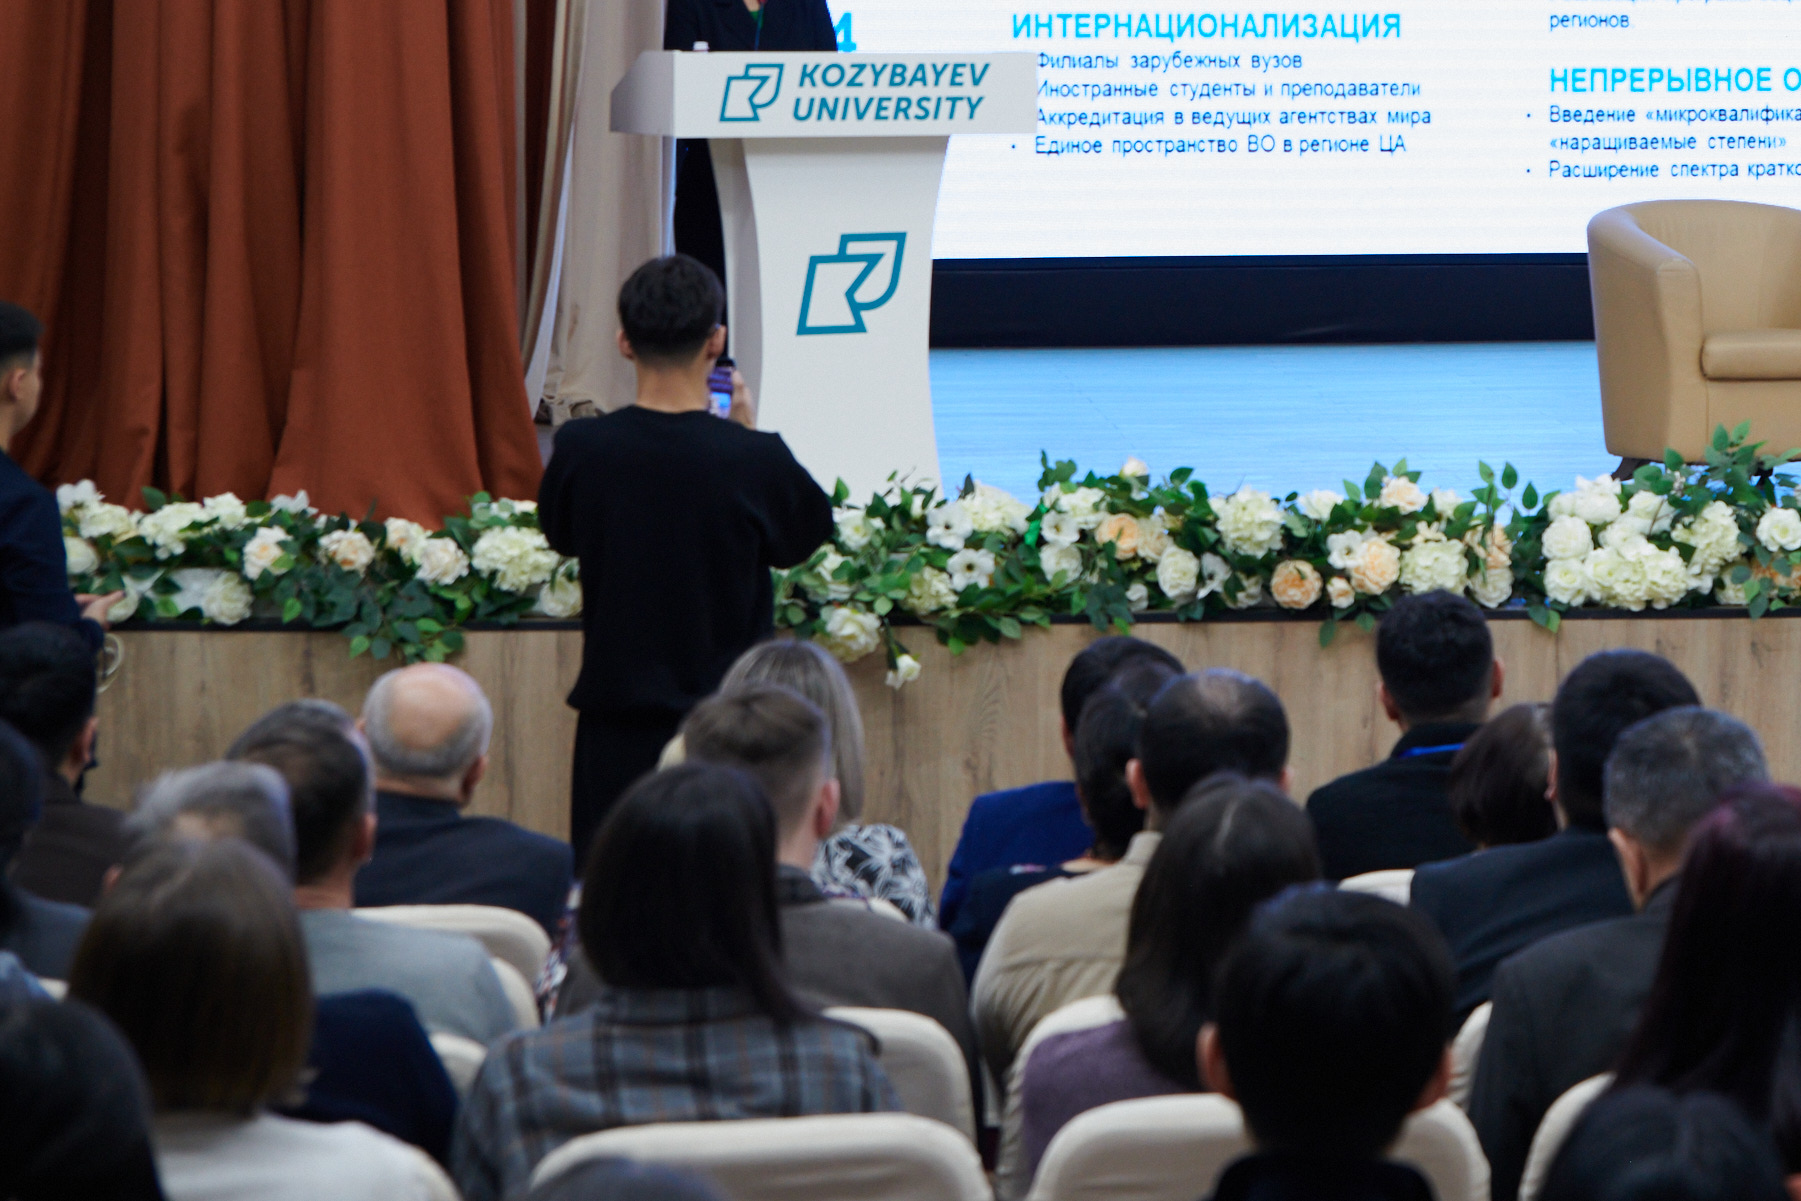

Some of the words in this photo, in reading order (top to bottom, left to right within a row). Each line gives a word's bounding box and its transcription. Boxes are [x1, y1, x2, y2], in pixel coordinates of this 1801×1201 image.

[1013, 13, 1400, 43] ИНТЕРНАЦИОНАЛИЗАЦИЯ
[1038, 51, 1119, 69] Филиалы
[1131, 49, 1240, 74] зарубежных
[1251, 54, 1302, 73] вузов
[798, 62, 991, 88] KOZYBAYEV
[1550, 66, 1772, 93] НЕПРЕРЫВНОЕ
[1038, 79, 1158, 101] Иностранные
[1170, 83, 1256, 101] студенты
[1264, 84, 1273, 96] и
[1281, 82, 1420, 100] преподаватели
[793, 95, 985, 121] UNIVERSITY
[1549, 159, 1659, 181] Расширение
[1671, 163, 1739, 180] спектра
